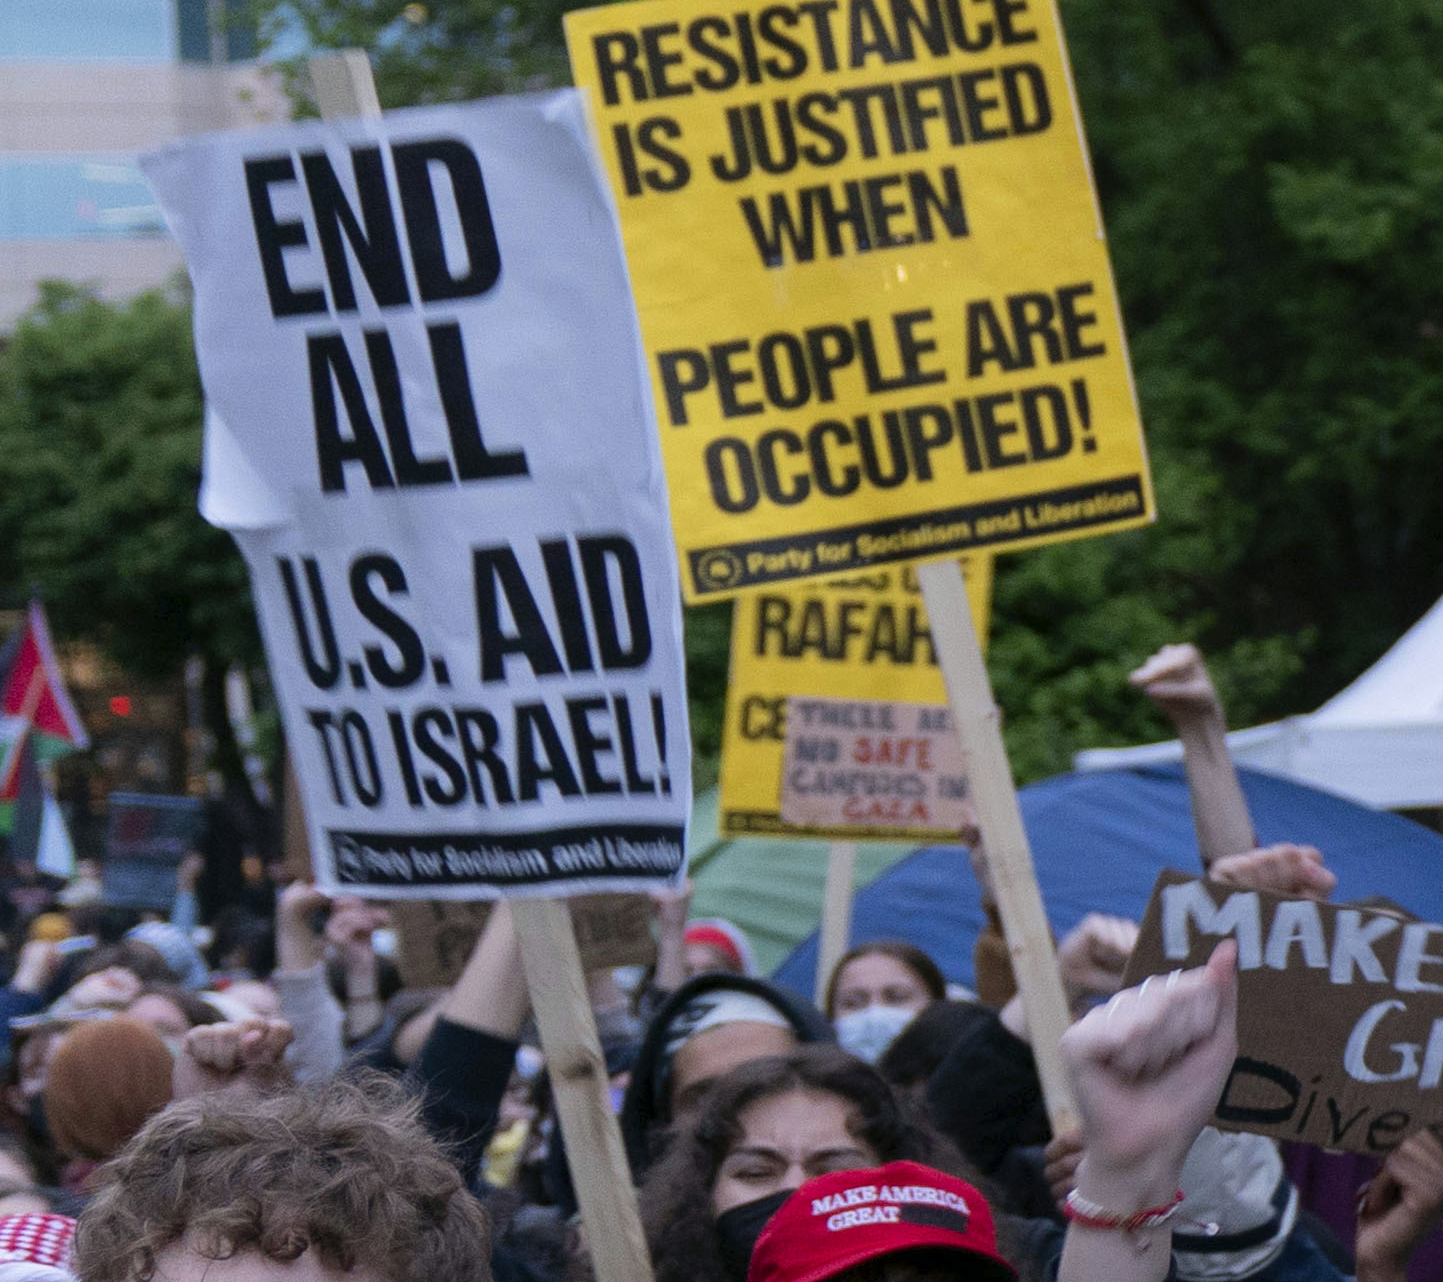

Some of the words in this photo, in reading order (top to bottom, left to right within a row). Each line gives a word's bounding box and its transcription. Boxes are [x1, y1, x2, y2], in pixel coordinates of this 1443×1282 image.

[613, 116, 691, 196] IS
[709, 62, 1052, 182] JUSTIFIED
[243, 138, 502, 321] END
[739, 166, 969, 268] WHEN
[306, 319, 532, 494] ALL
[657, 308, 946, 428] PEOPLE
[966, 282, 1105, 378] ARE
[703, 378, 1097, 513] OCCUPIED!
[746, 548, 813, 577] Party
[815, 541, 852, 564] for
[855, 519, 972, 558] Socialism
[975, 506, 1021, 537] and
[1022, 489, 1140, 530] Liberation
[277, 552, 453, 691] U.S.
[471, 531, 652, 684] AID
[306, 707, 383, 808] TO
[385, 690, 673, 808] ISRAEL!
[851, 737, 934, 771] SAFE
[442, 843, 549, 878] Socialism
[551, 834, 607, 872] and
[811, 1185, 878, 1216] MAKE
[879, 1185, 971, 1216] AMERICA
[827, 1205, 900, 1232] GREAT
